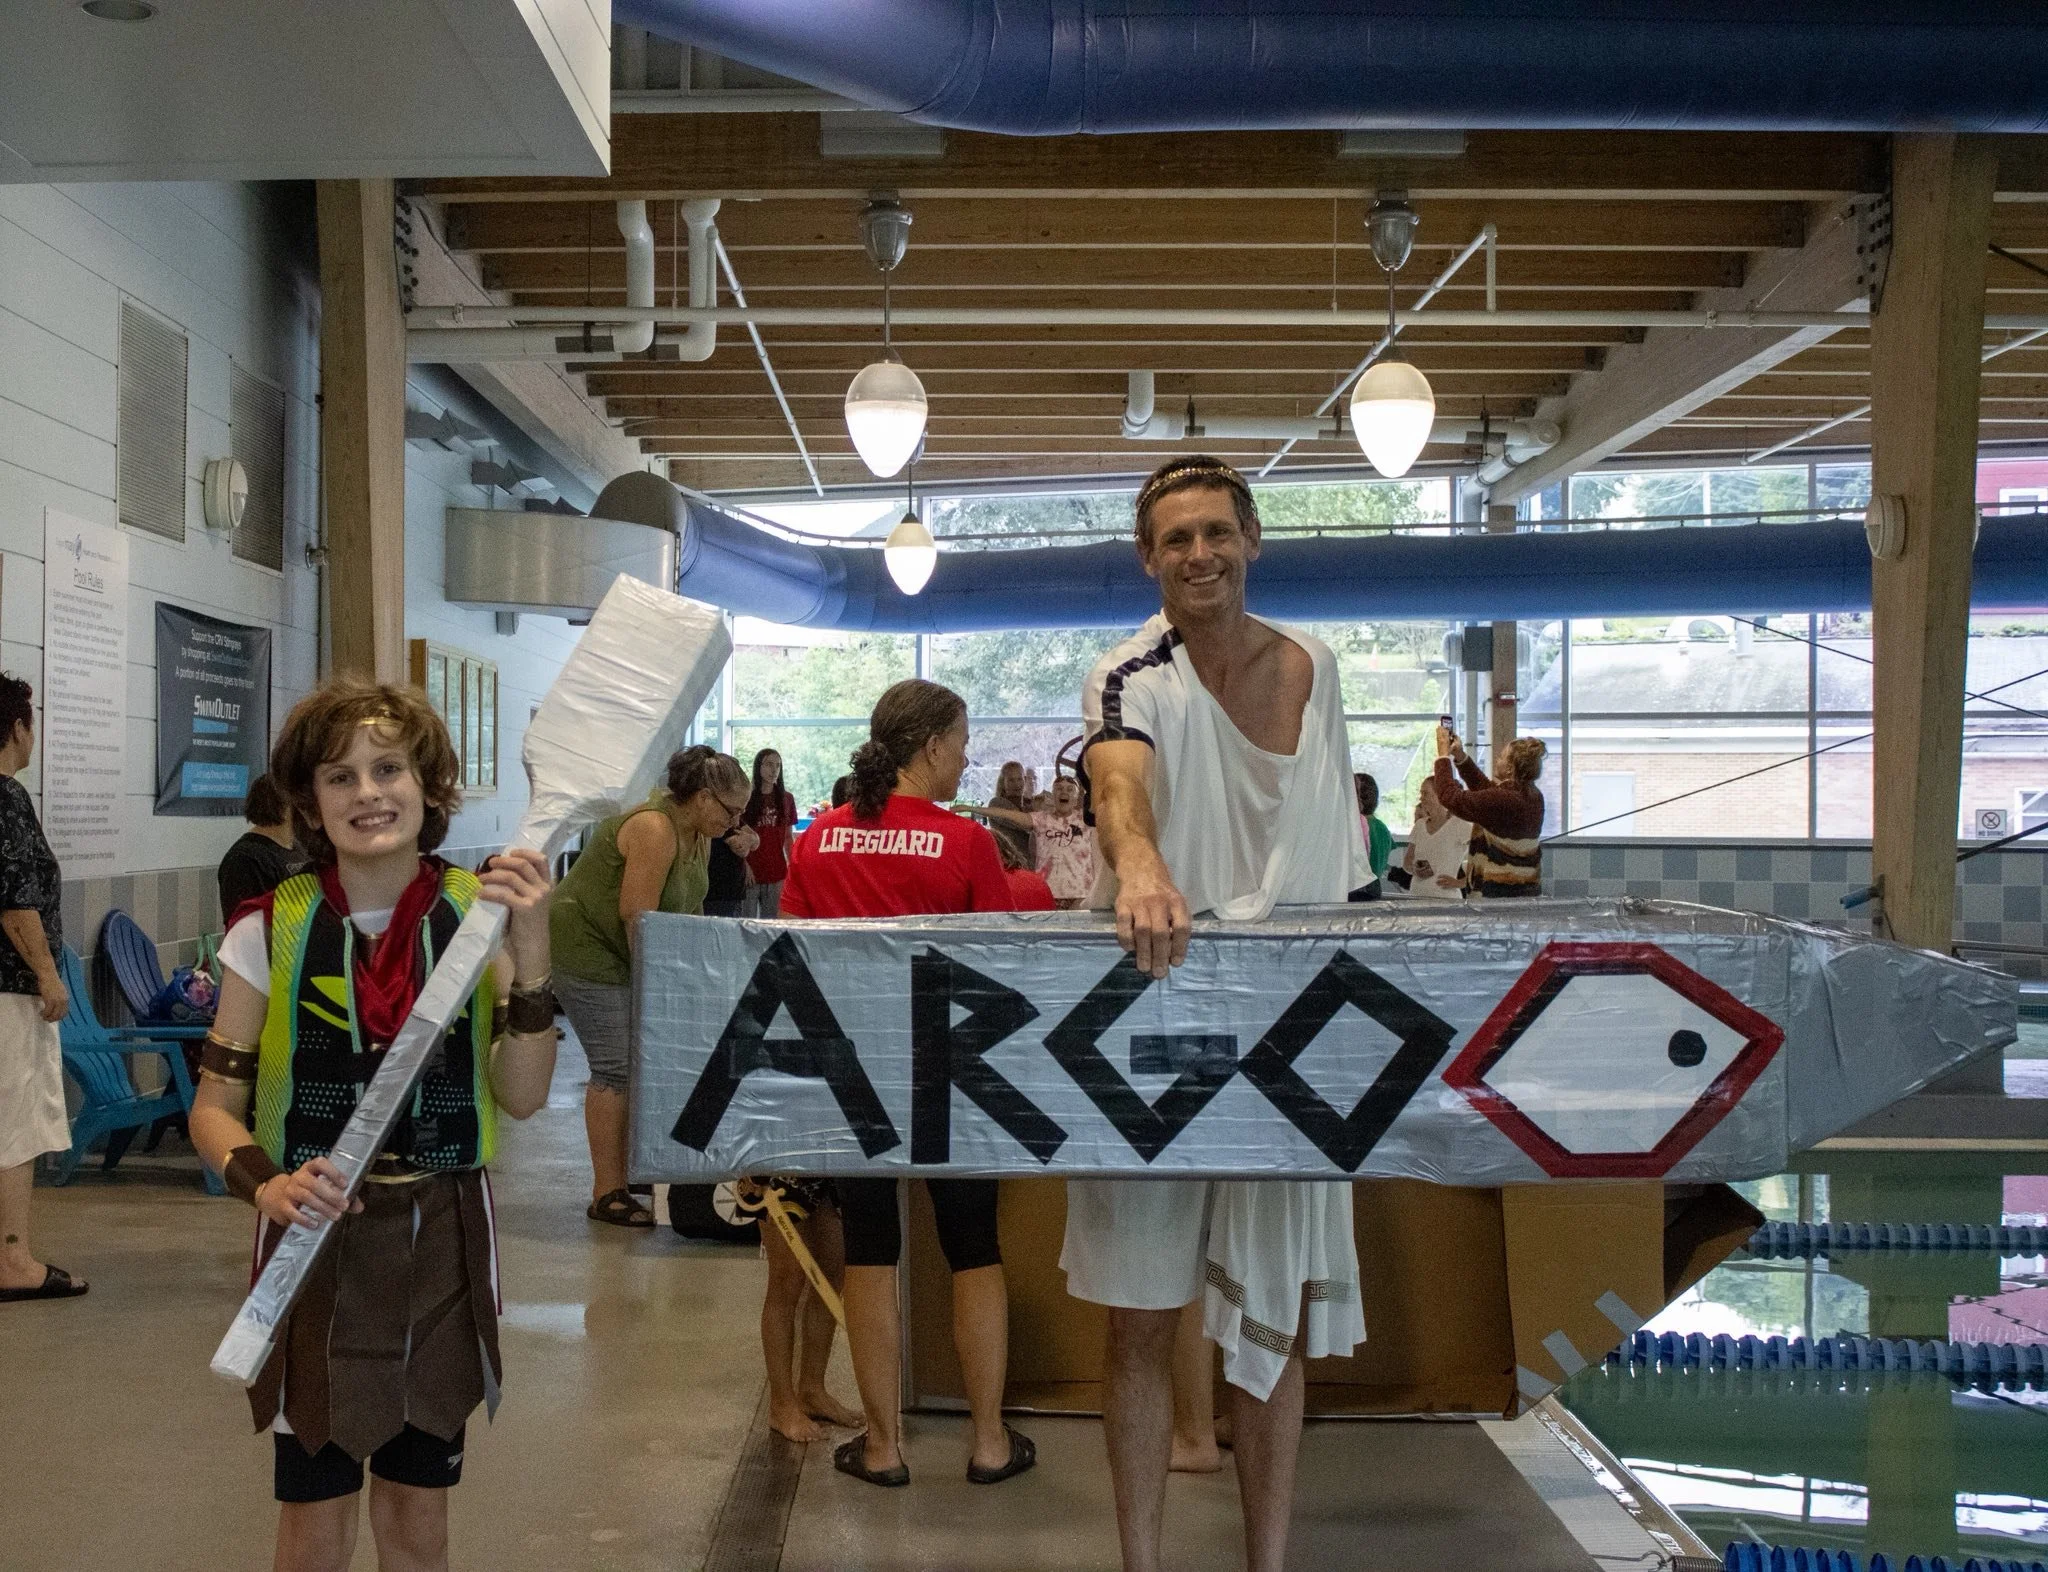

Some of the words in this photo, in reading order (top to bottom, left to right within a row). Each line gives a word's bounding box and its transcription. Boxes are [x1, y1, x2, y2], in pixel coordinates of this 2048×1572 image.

[74, 568, 87, 585] Pool
[88, 572, 104, 590] Rules
[192, 628, 207, 643] Support
[215, 634, 224, 646] CRV
[182, 647, 187, 659] by
[188, 648, 206, 663] shopping
[180, 668, 195, 680] portion
[818, 827, 944, 859] LIFEGUARD
[669, 931, 1458, 1172] ARGO
